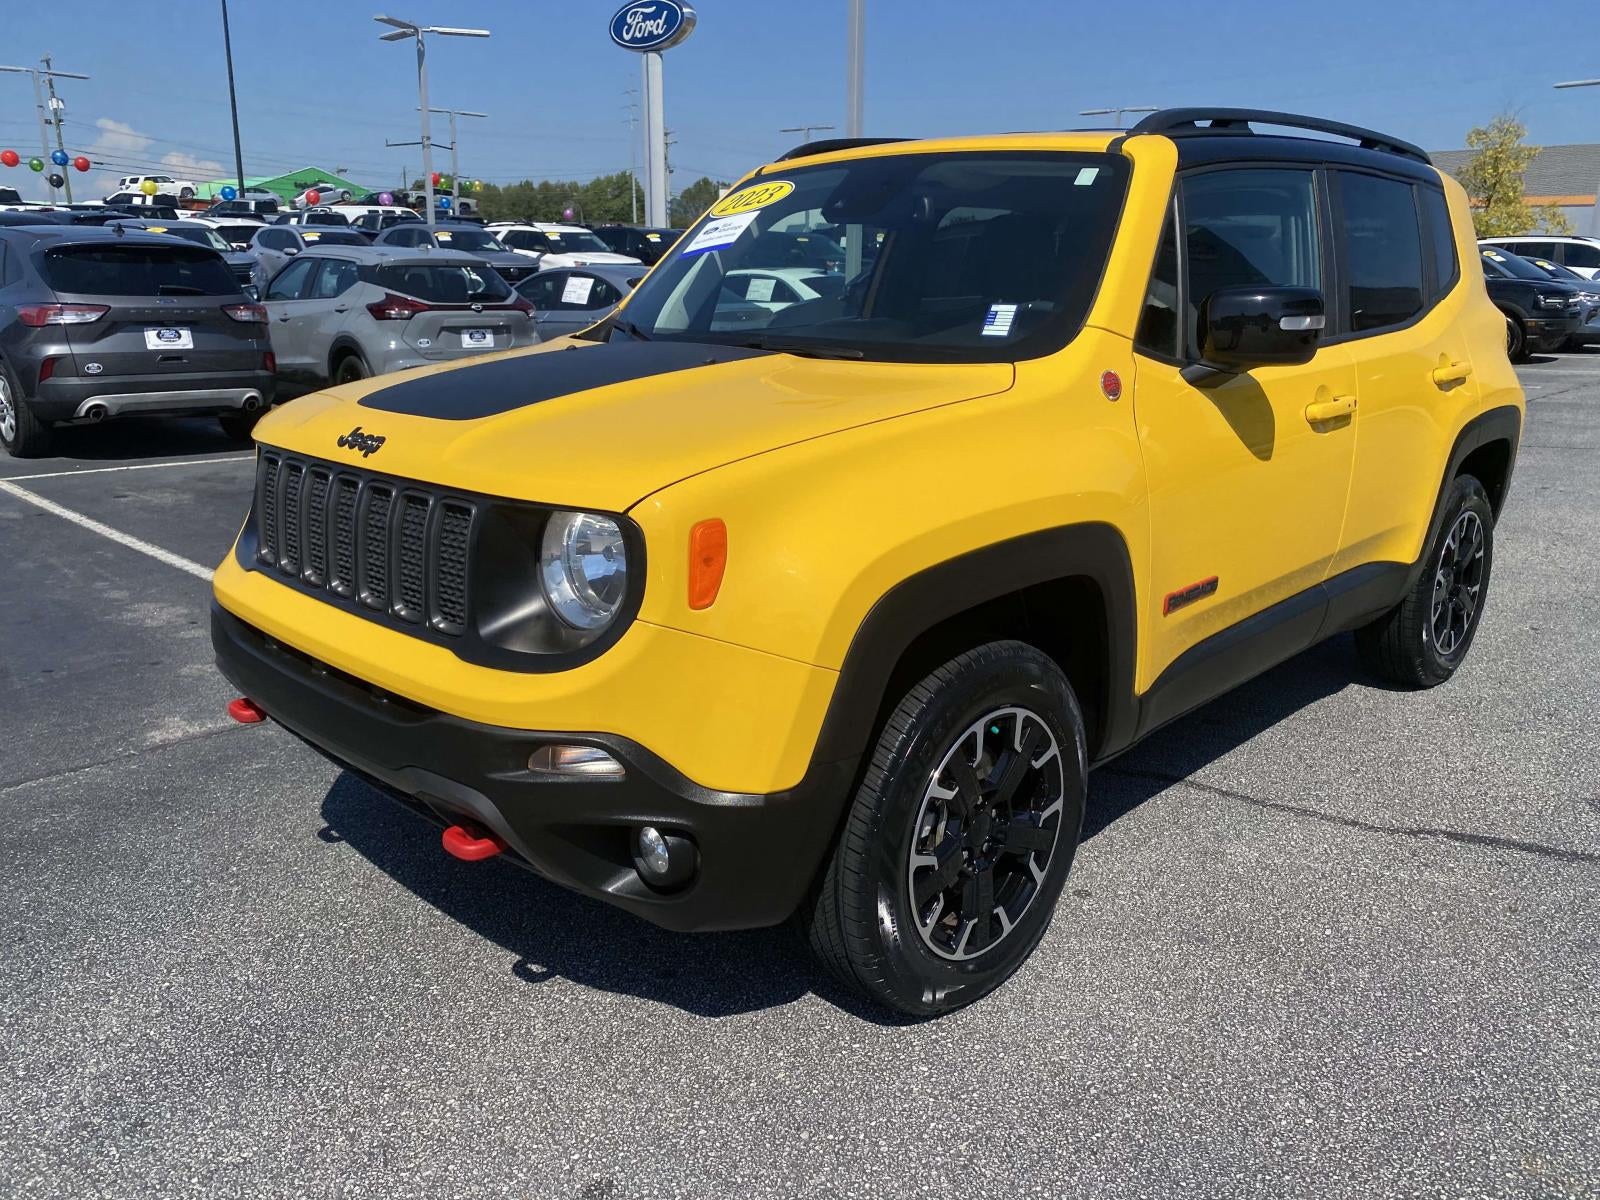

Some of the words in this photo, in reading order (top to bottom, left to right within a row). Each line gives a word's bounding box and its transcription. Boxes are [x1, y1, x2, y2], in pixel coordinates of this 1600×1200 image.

[622, 6, 668, 41] Ford
[717, 185, 785, 214] 2023
[336, 426, 386, 458] Jeep
